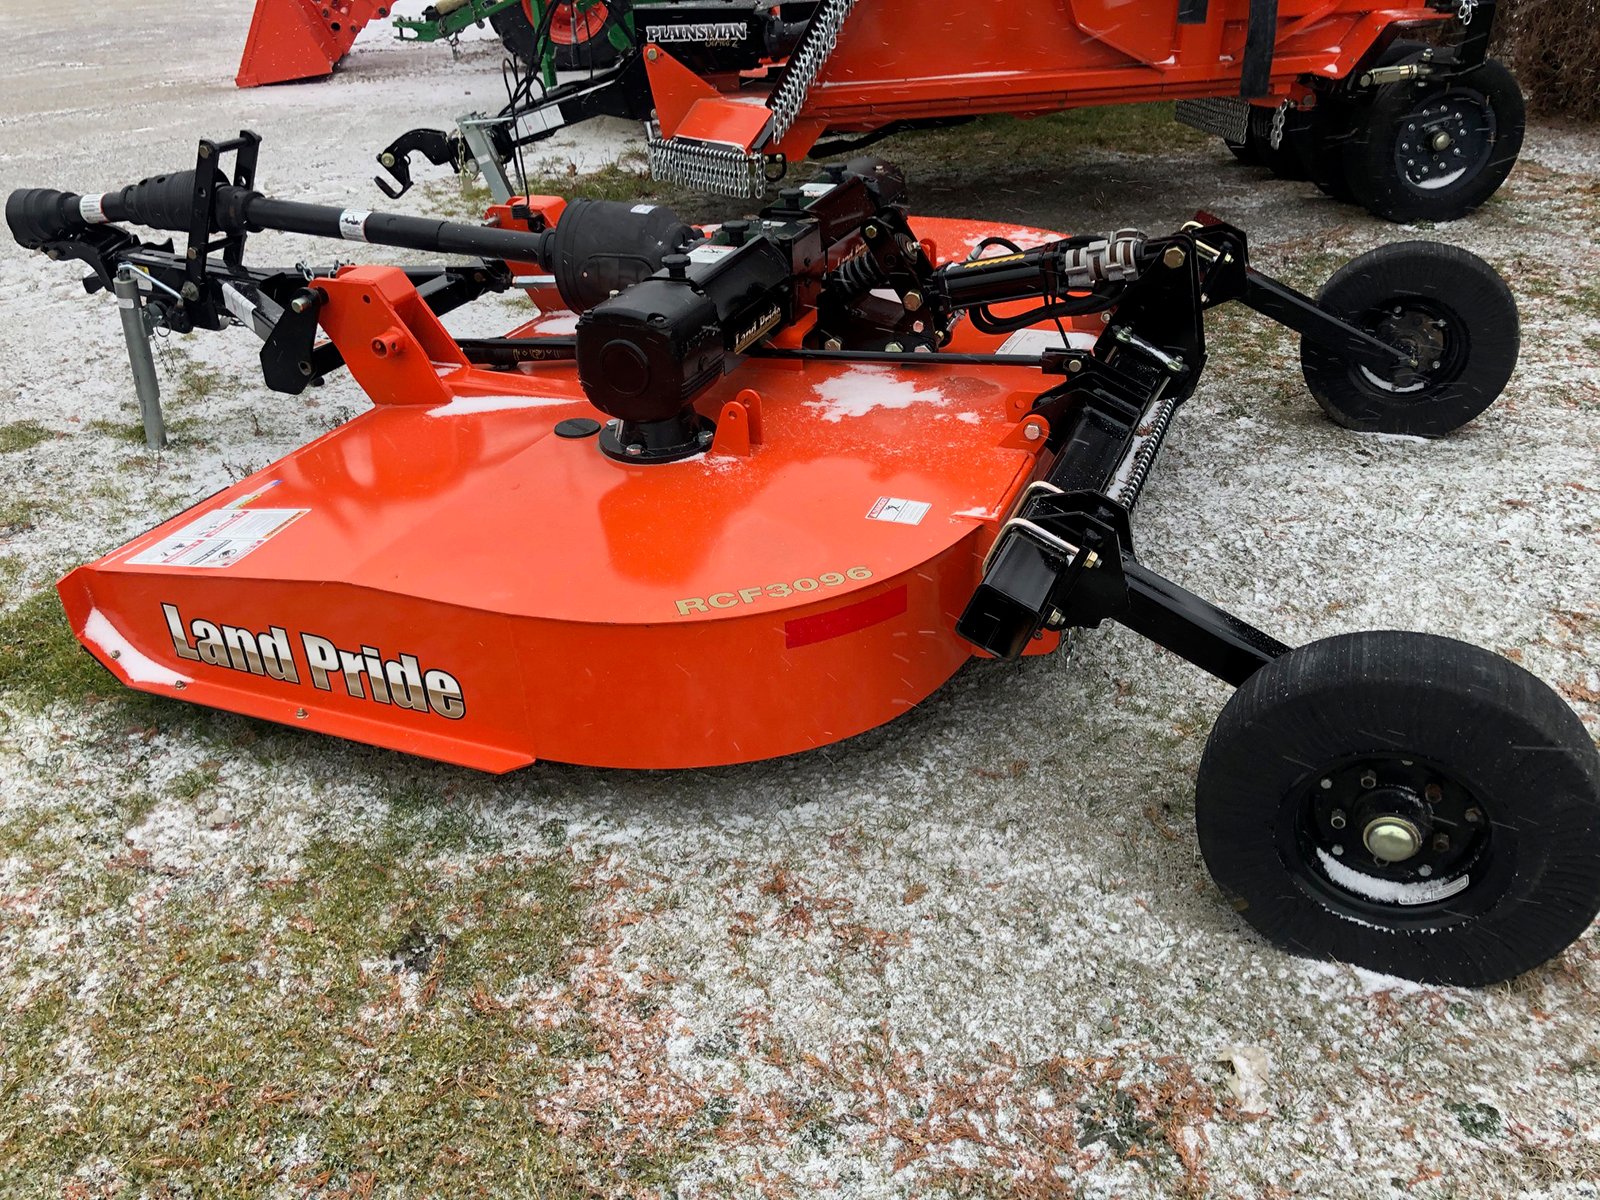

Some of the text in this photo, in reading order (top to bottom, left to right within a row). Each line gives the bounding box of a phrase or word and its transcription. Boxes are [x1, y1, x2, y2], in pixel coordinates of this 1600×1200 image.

[646, 22, 747, 43] PLAINSMAN
[735, 320, 757, 345] Land
[759, 305, 781, 327] Pride
[674, 566, 873, 616] RCF3096
[160, 602, 466, 720] Land Pride
